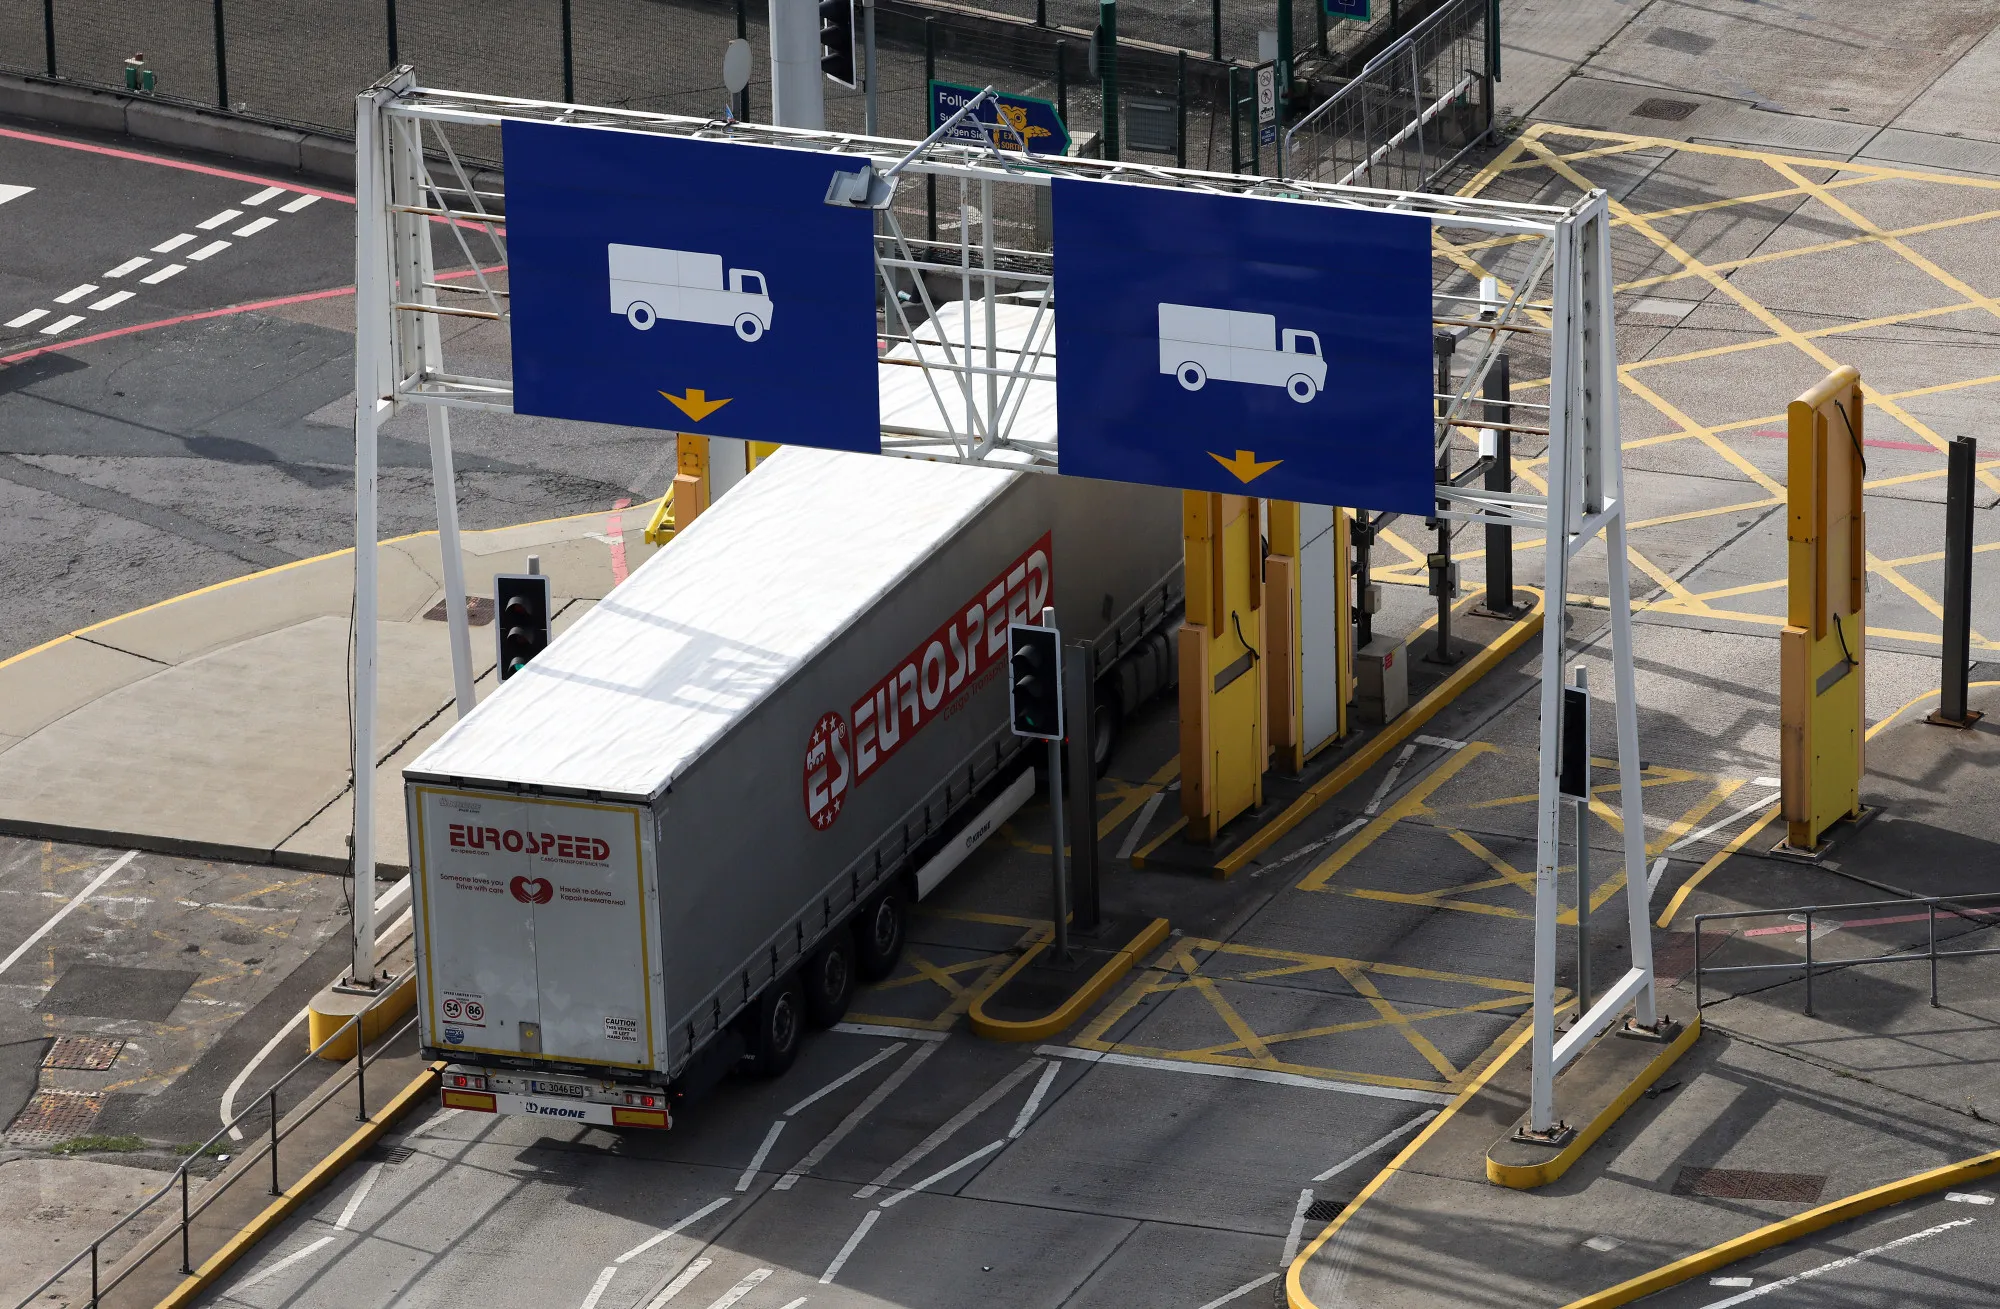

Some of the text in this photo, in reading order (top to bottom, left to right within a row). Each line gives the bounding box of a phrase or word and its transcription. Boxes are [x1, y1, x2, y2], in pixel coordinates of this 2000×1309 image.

[854, 549, 1050, 777] EUROSPEED
[449, 823, 611, 861] EUROSPEED
[450, 847, 490, 857] eu-speed.com
[540, 856, 558, 864] CARGO
[440, 873, 504, 888] Someone loves you
[456, 883, 473, 891] Drive
[474, 885, 488, 893] with
[559, 885, 581, 894] Някой
[590, 889, 612, 897] обича
[560, 893, 626, 906] Карай внимателно!
[446, 1002, 459, 1013] 54
[468, 1005, 481, 1016] 86
[605, 1018, 636, 1027] CAUTION
[540, 1106, 586, 1119] KRONE
